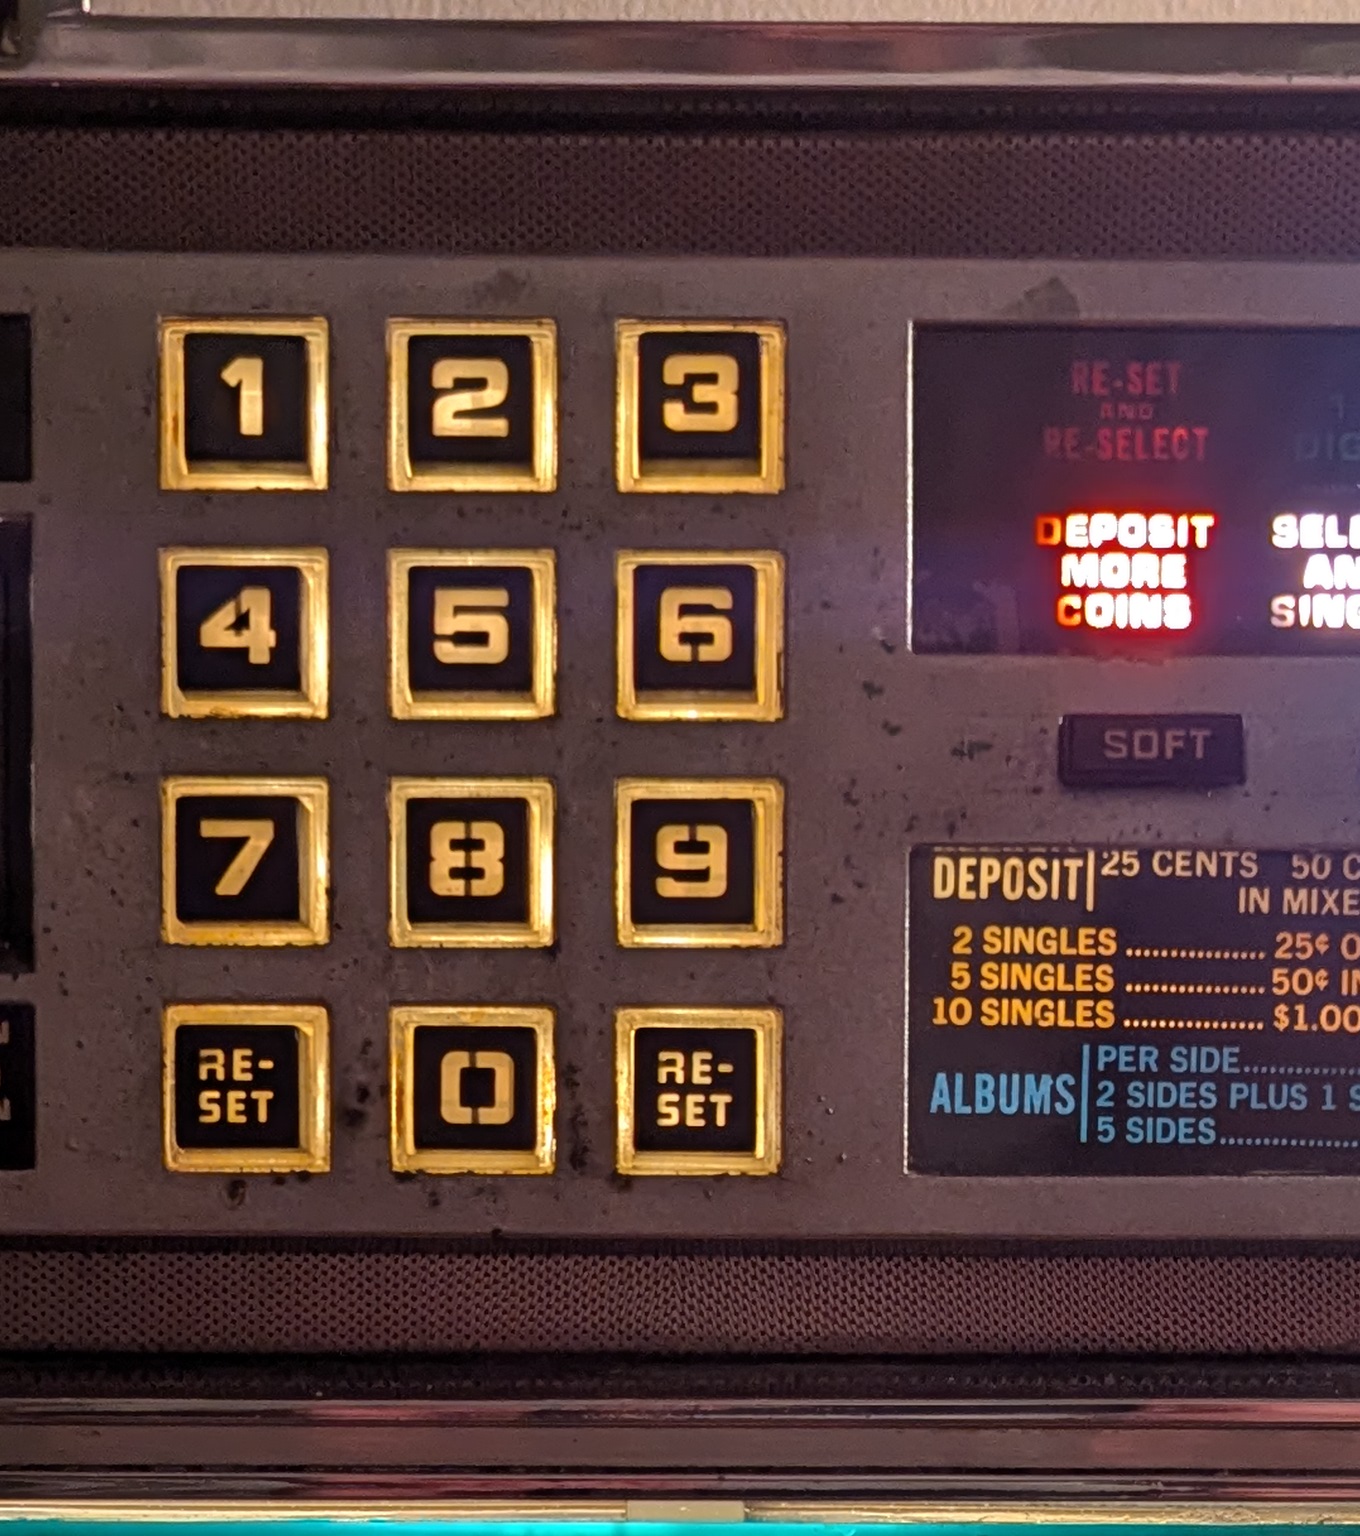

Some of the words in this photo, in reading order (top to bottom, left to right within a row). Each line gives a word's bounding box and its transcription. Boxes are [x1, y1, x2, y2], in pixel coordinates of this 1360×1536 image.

[663, 355, 739, 432] 3
[1072, 362, 1181, 396] RE-SET
[221, 358, 264, 436] 1
[432, 359, 509, 437] 2
[1100, 402, 1153, 421] AND
[1044, 425, 1208, 461] RE-SELECT
[1036, 514, 1215, 549] DEPOSIT
[1061, 555, 1187, 589] MORE
[200, 588, 277, 664] 4
[433, 589, 509, 664] 5
[659, 588, 733, 662] 6
[1056, 595, 1192, 629] COINS
[1104, 728, 1211, 760] SOFT
[200, 819, 275, 896] 7
[429, 821, 505, 897] 8
[656, 825, 728, 898] 9
[1100, 850, 1140, 877] 25
[1152, 850, 1258, 878] CENTS
[1292, 854, 1332, 880] 50
[933, 856, 1084, 901] DEPOSIT
[1238, 886, 1270, 914] IN
[952, 925, 973, 955] 2
[982, 925, 1117, 956] SINGLES
[1274, 931, 1330, 960] 25¢
[951, 961, 971, 991] 5
[980, 961, 1115, 993] SINGLES
[1271, 967, 1329, 996] 50¢
[932, 997, 973, 1026] 10
[980, 997, 1115, 1029] SINGLES
[199, 1048, 274, 1082] RE-
[657, 1051, 733, 1085] RE-
[1097, 1044, 1159, 1073] PER
[1169, 1046, 1241, 1074] SIDE
[440, 1050, 515, 1125] 0
[929, 1072, 1076, 1115] ALBUMS
[1096, 1080, 1115, 1108] 2
[1126, 1080, 1218, 1109] SIDES
[1229, 1082, 1308, 1111] PLUS
[1321, 1084, 1336, 1111] 1
[198, 1090, 274, 1124] SET
[657, 1092, 733, 1127] SET
[1097, 1115, 1116, 1143] 5
[1125, 1116, 1216, 1145] SIDES
